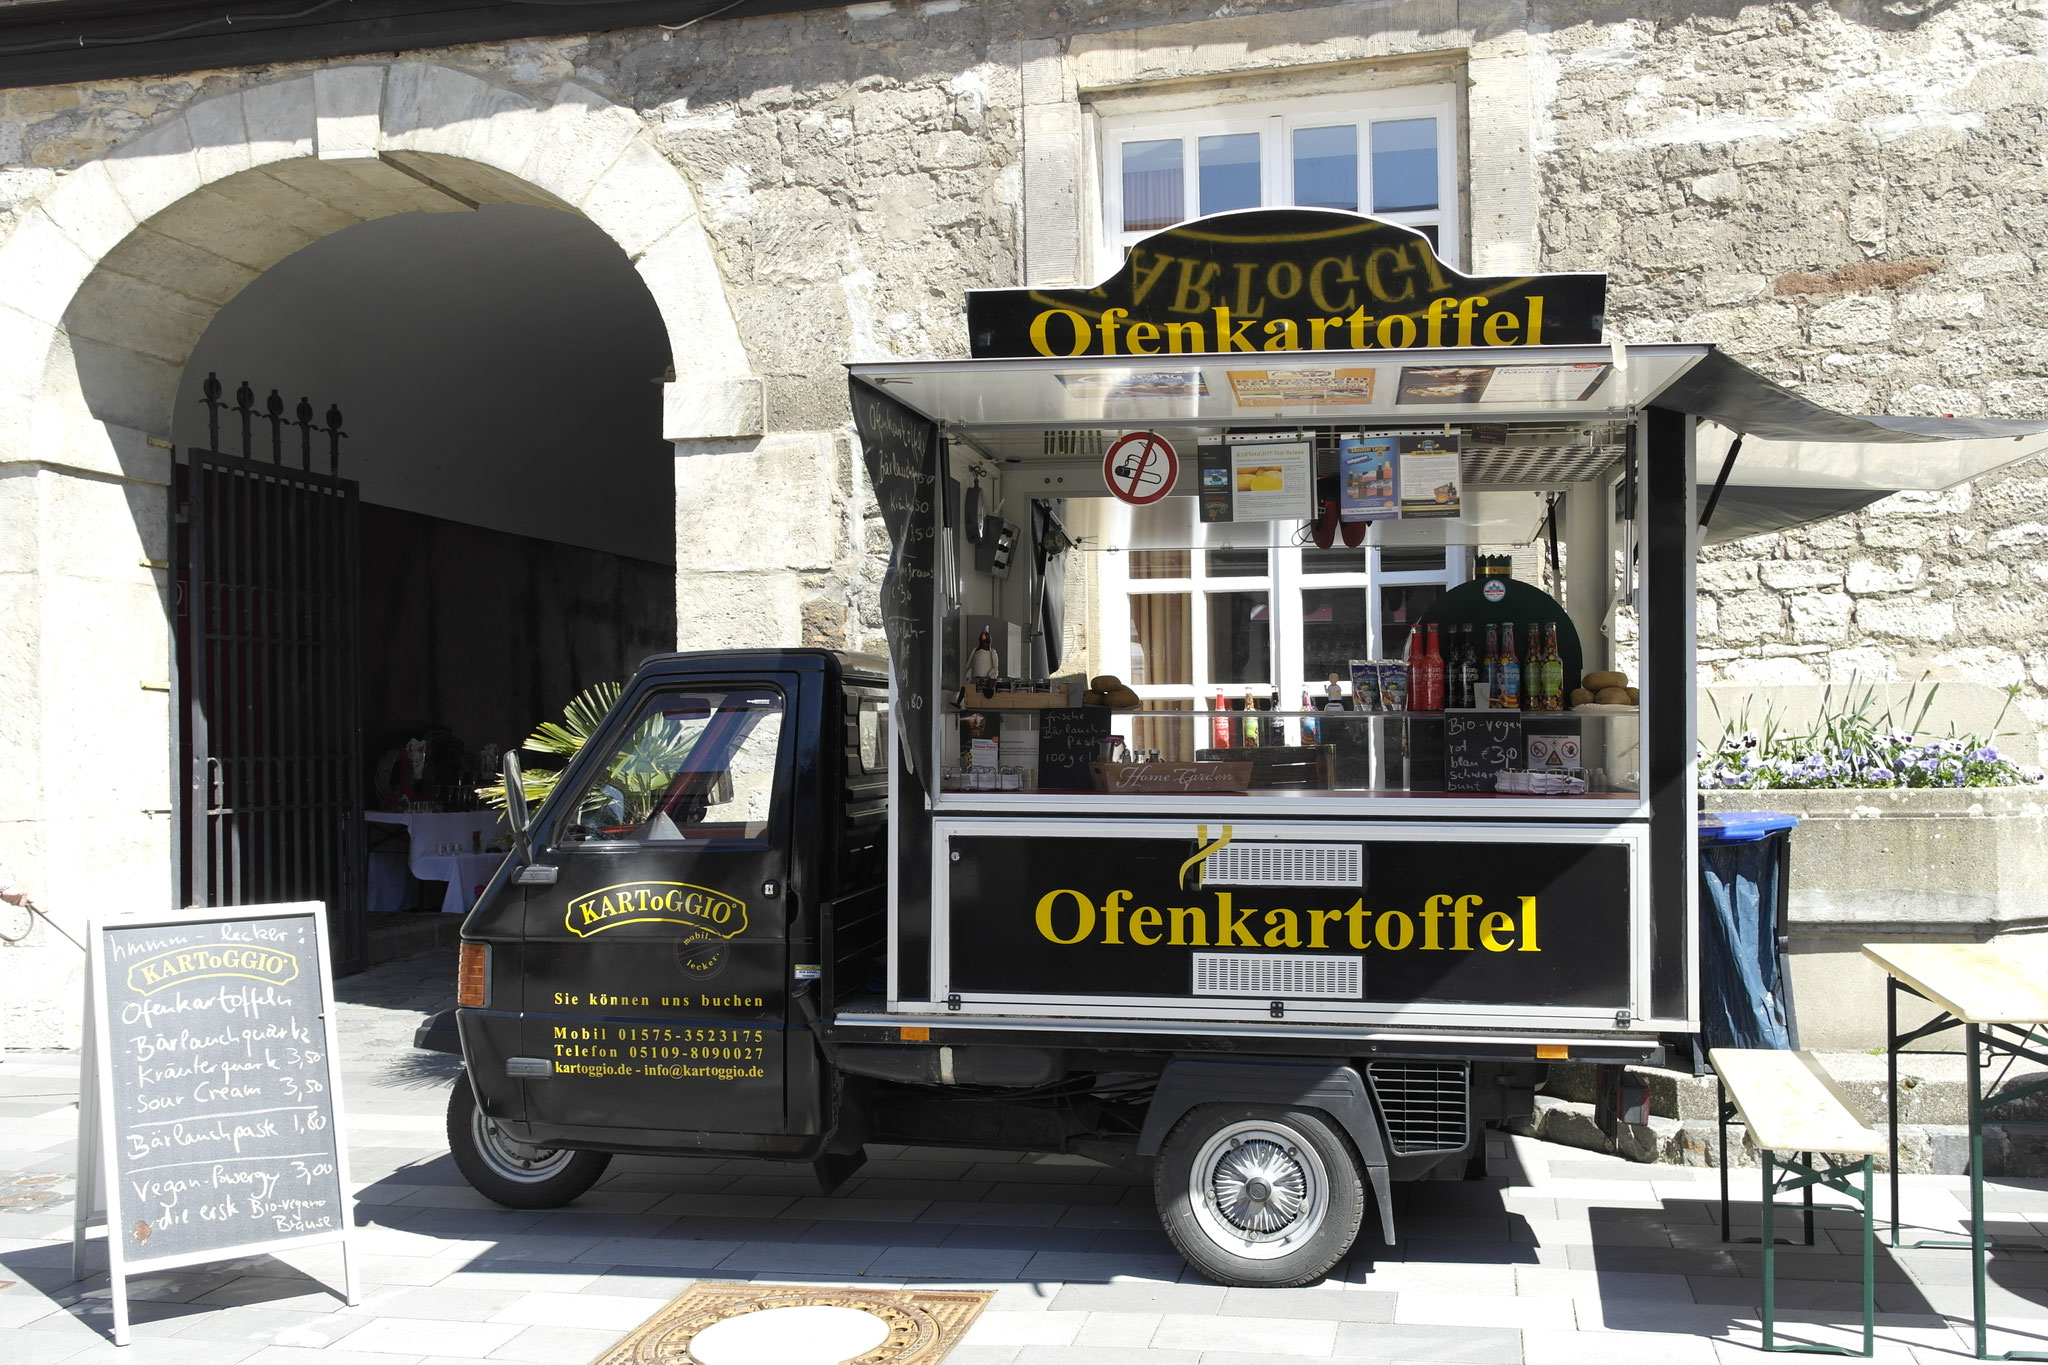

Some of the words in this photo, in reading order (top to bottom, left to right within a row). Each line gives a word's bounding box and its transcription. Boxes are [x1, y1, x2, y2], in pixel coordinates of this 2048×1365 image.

[1029, 295, 1544, 358] Ofenkartoffel
[1449, 739, 1467, 754] rot
[1451, 757, 1479, 769] blau
[1116, 765, 1171, 788] Home
[1173, 765, 1234, 791] Garden
[1447, 781, 1481, 792] bunt
[1034, 888, 1542, 953] Ofenkartoffel
[553, 991, 579, 1006] Sie
[589, 992, 649, 1006] können
[661, 996, 690, 1007] uns
[701, 994, 763, 1007] buchen
[553, 1026, 607, 1041] Mobil
[618, 1028, 763, 1043] 01575-3523175
[553, 1044, 618, 1058] Telefon
[629, 1046, 763, 1060] 05109-8090027
[555, 1061, 633, 1078] kartoggio.de
[644, 1064, 765, 1080] info@kartoggio.de
[137, 1094, 185, 1113] Sour
[193, 1081, 262, 1102] Cream
[279, 1077, 323, 1103] 3,50
[293, 1110, 327, 1135] 1,80
[290, 1161, 333, 1186] 3,00
